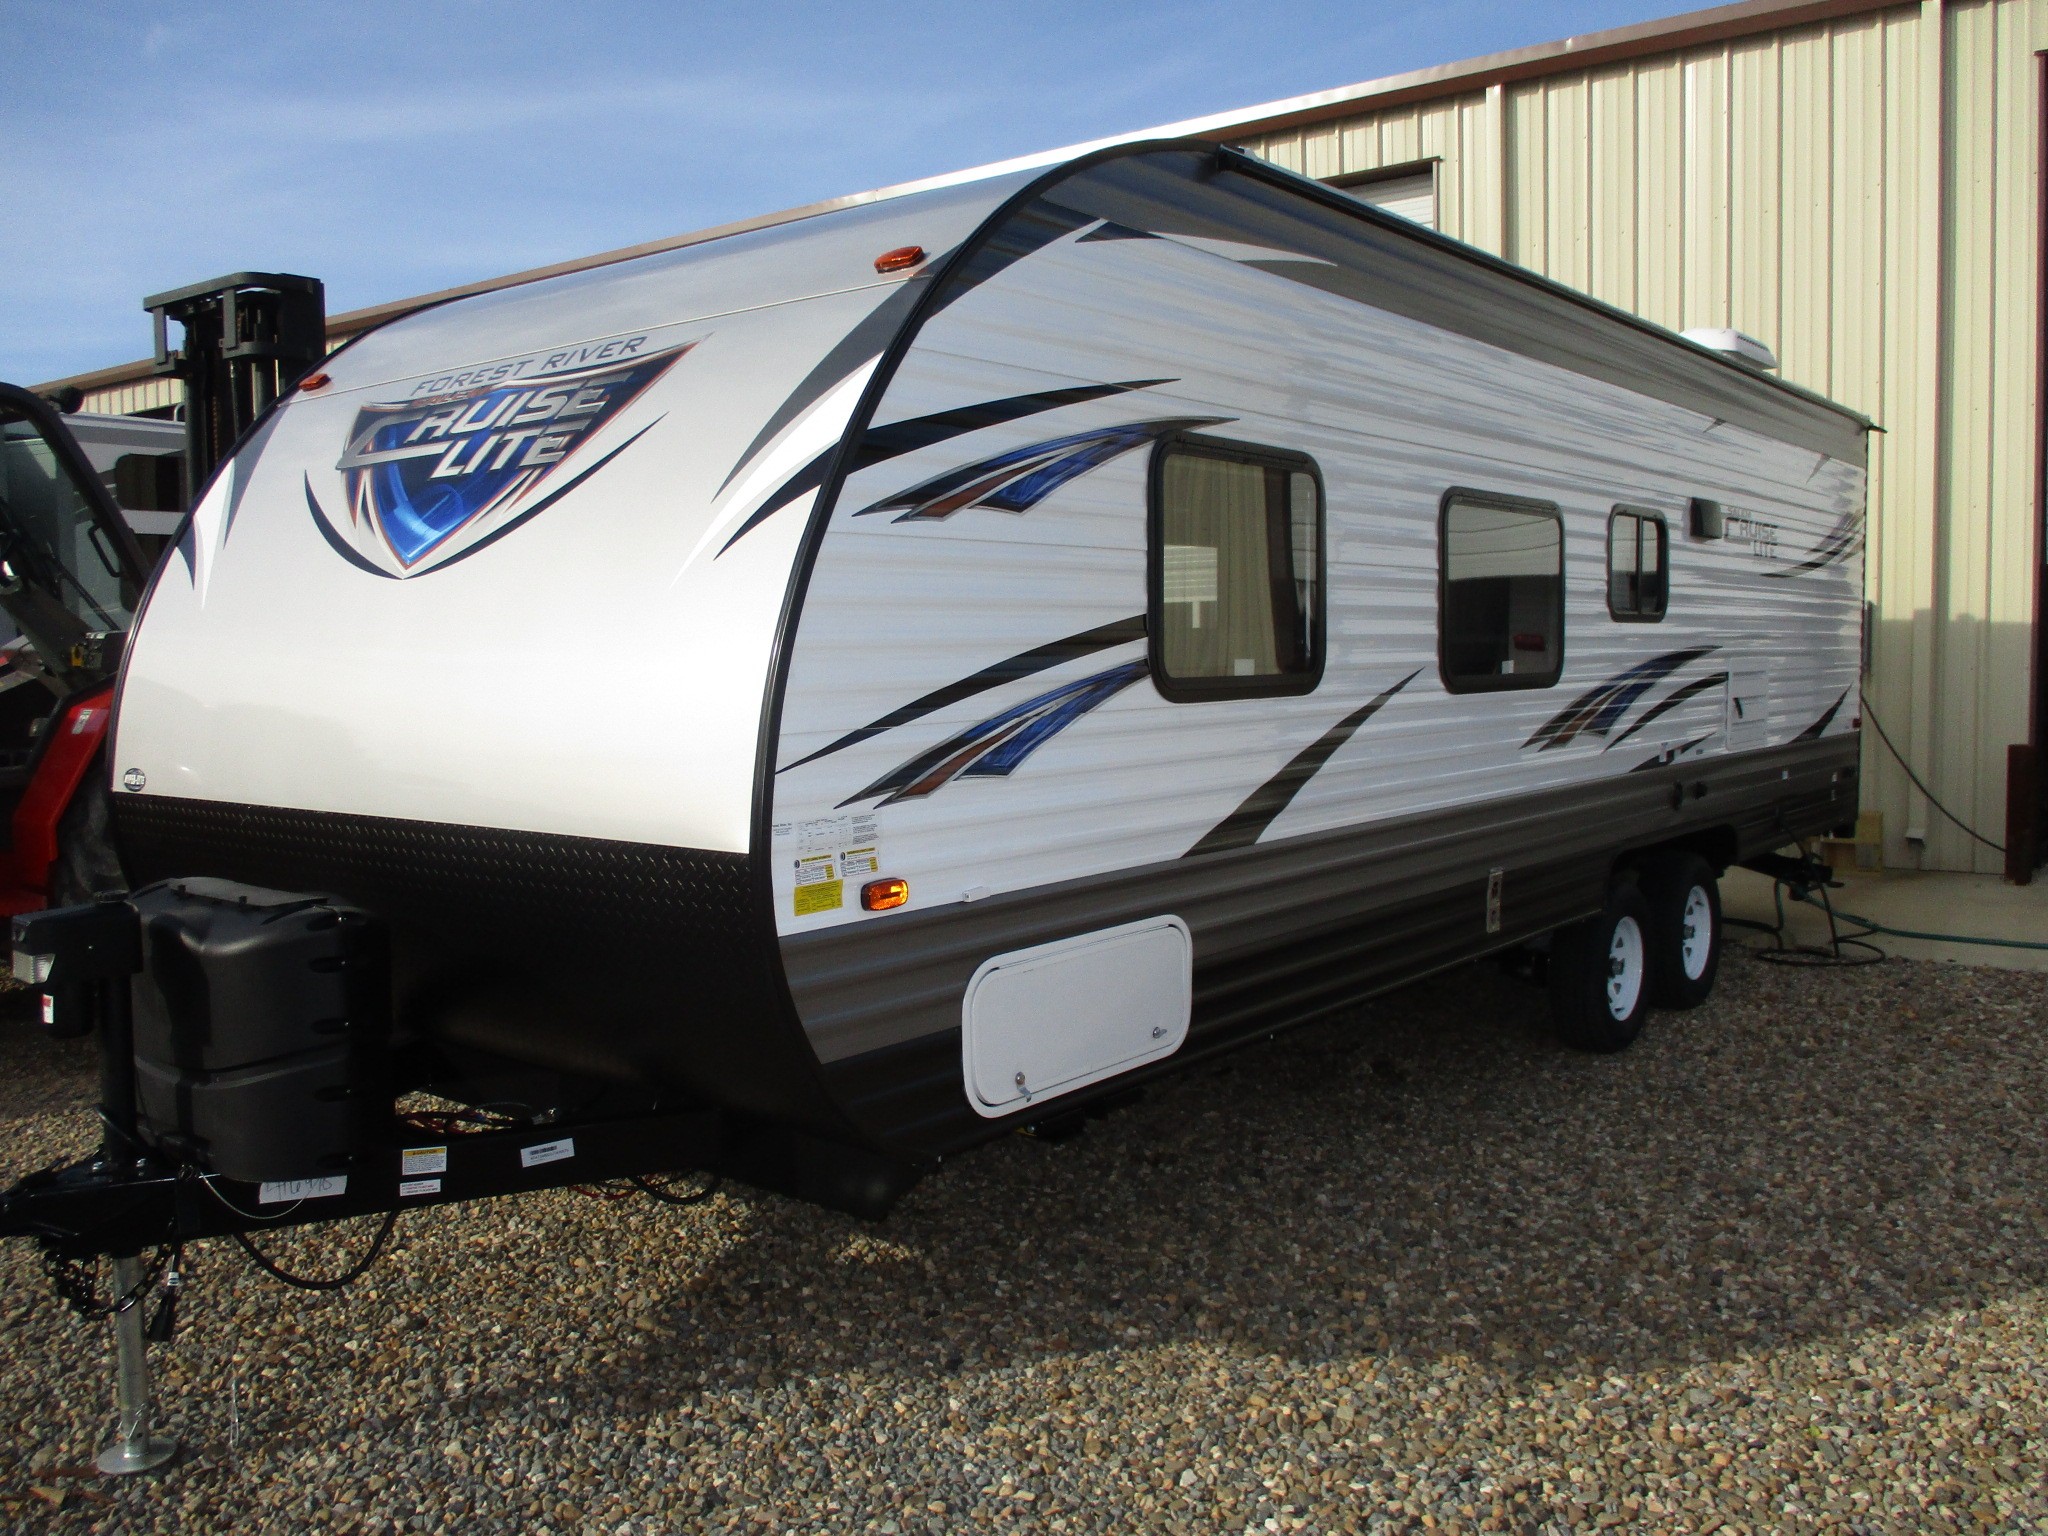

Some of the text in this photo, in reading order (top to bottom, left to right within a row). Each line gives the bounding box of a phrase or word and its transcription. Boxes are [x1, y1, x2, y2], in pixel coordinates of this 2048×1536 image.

[410, 336, 648, 396] FOREST RIVER
[335, 371, 634, 470] CRUISE
[427, 416, 593, 481] LITE
